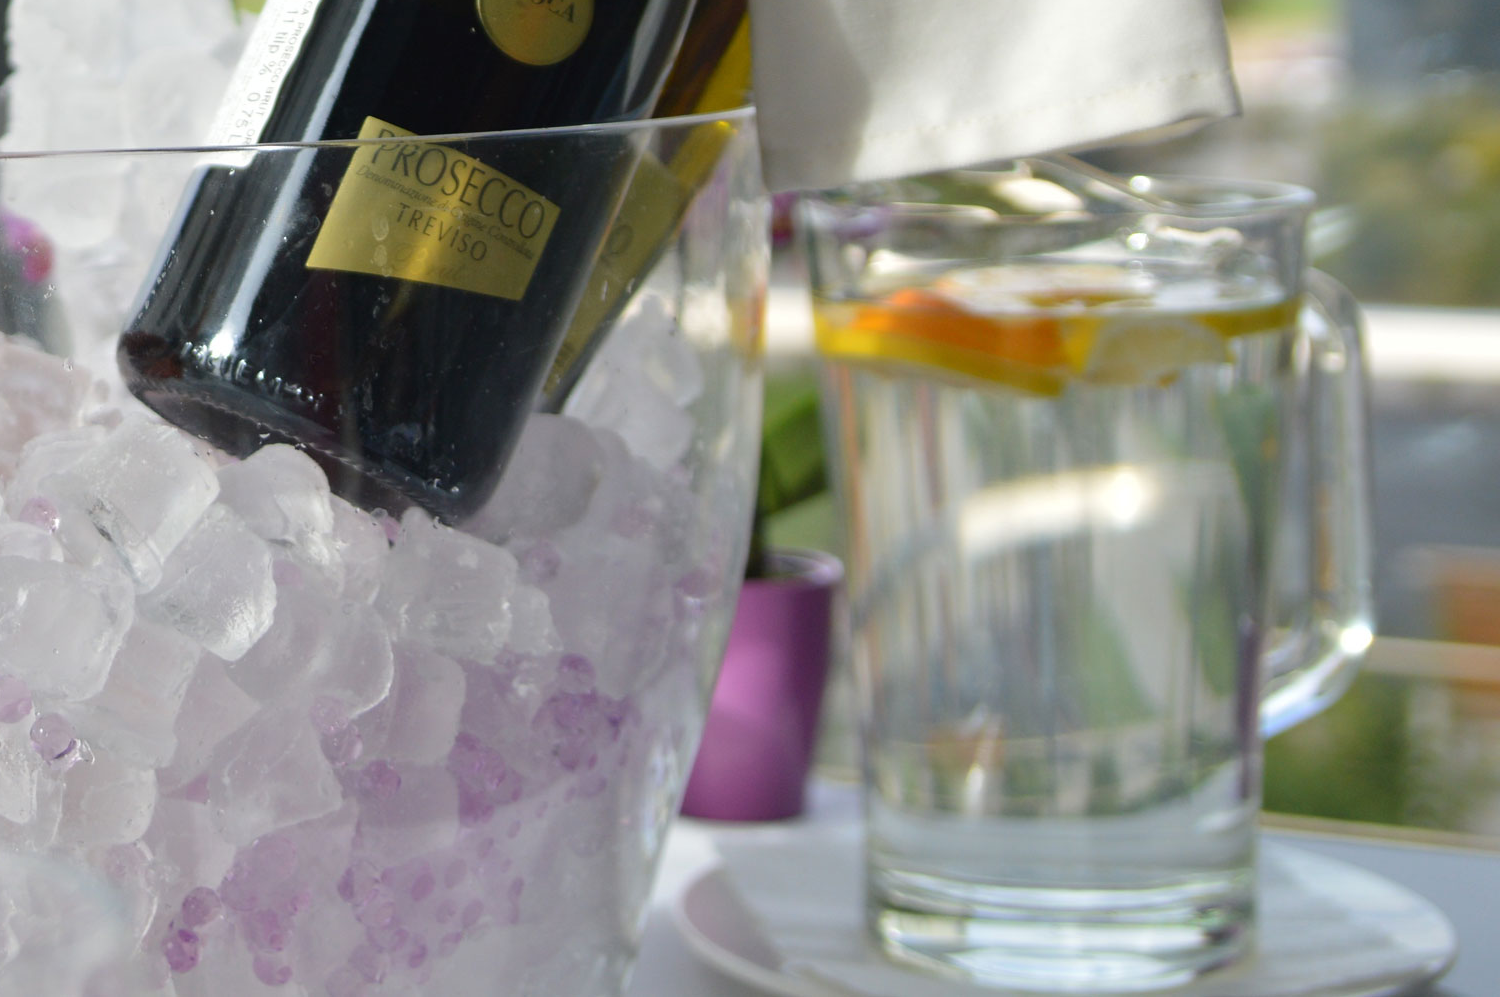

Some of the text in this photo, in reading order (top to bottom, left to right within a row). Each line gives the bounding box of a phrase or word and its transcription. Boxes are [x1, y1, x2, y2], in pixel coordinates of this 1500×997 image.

[268, 22, 305, 81] PROSECCO
[255, 87, 274, 116] BRUT
[371, 128, 545, 239] PROSECCO
[395, 201, 487, 261] TREVISO
